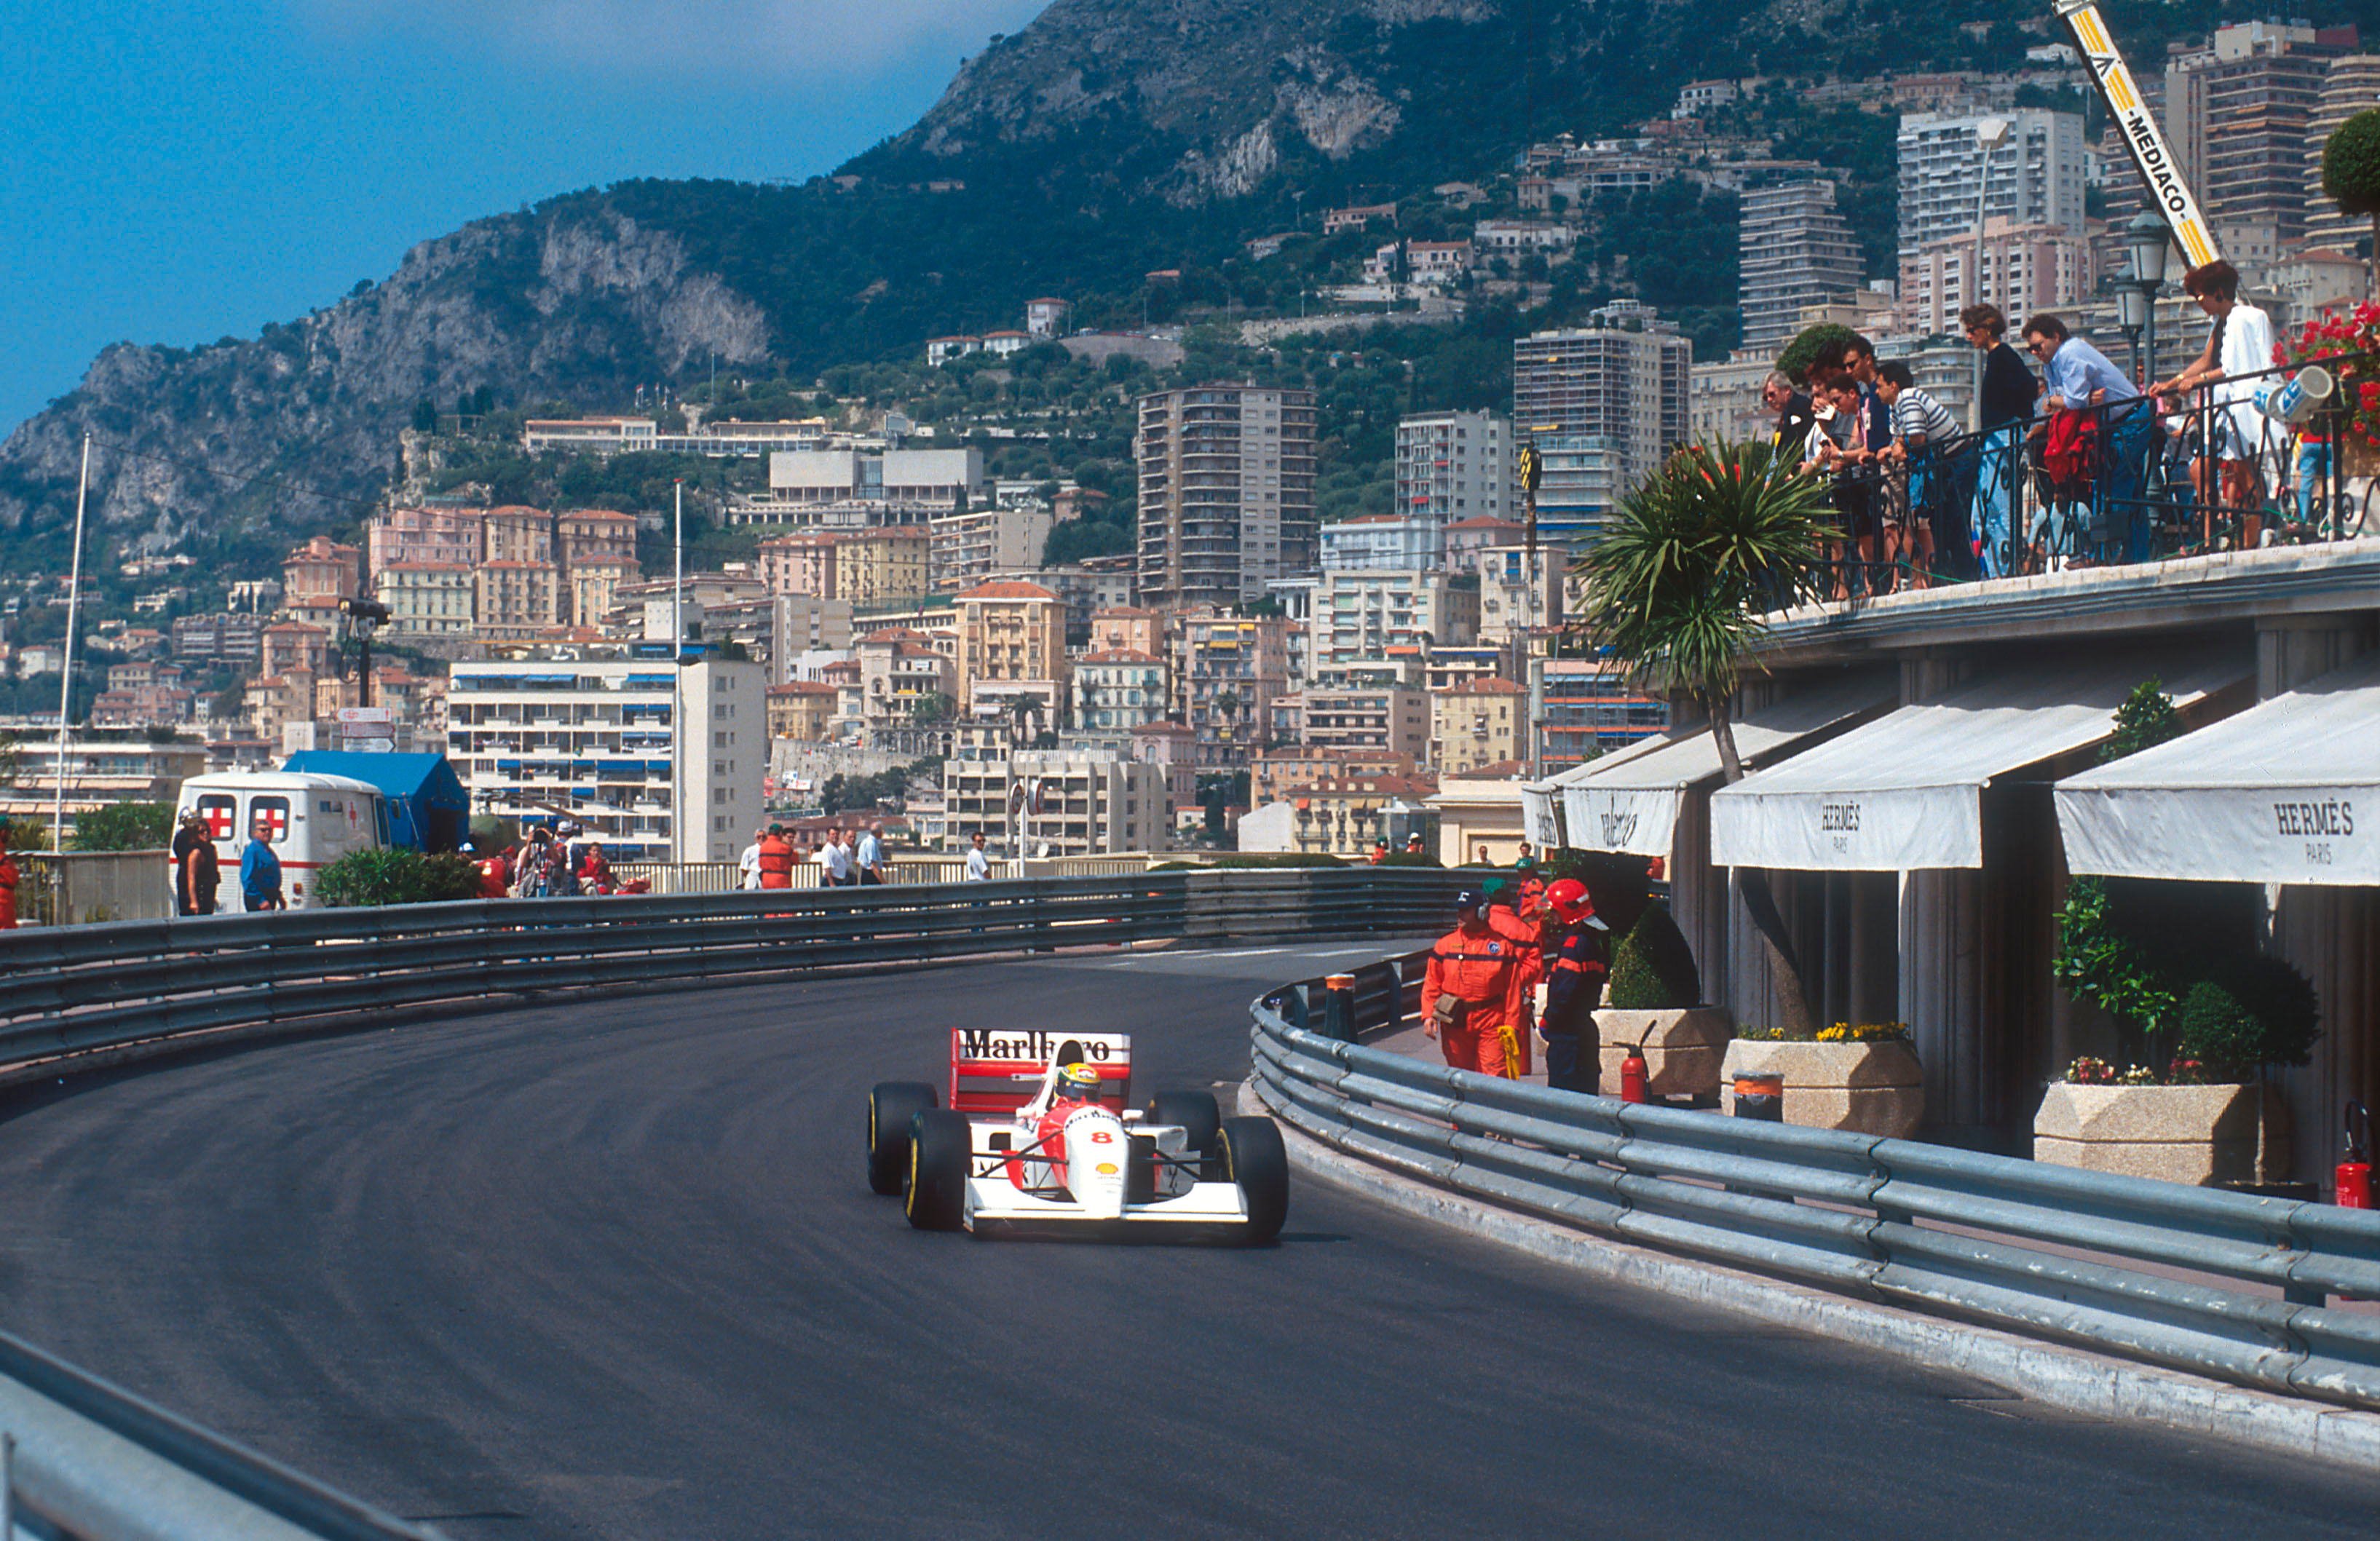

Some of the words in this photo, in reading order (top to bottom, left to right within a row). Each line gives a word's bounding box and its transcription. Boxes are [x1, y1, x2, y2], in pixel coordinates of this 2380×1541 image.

[2273, 797, 2354, 836] HERMÈS
[2306, 843, 2332, 865] PARIS
[965, 1029, 1110, 1061] Marlbo
[1091, 1132, 1113, 1144] 8
